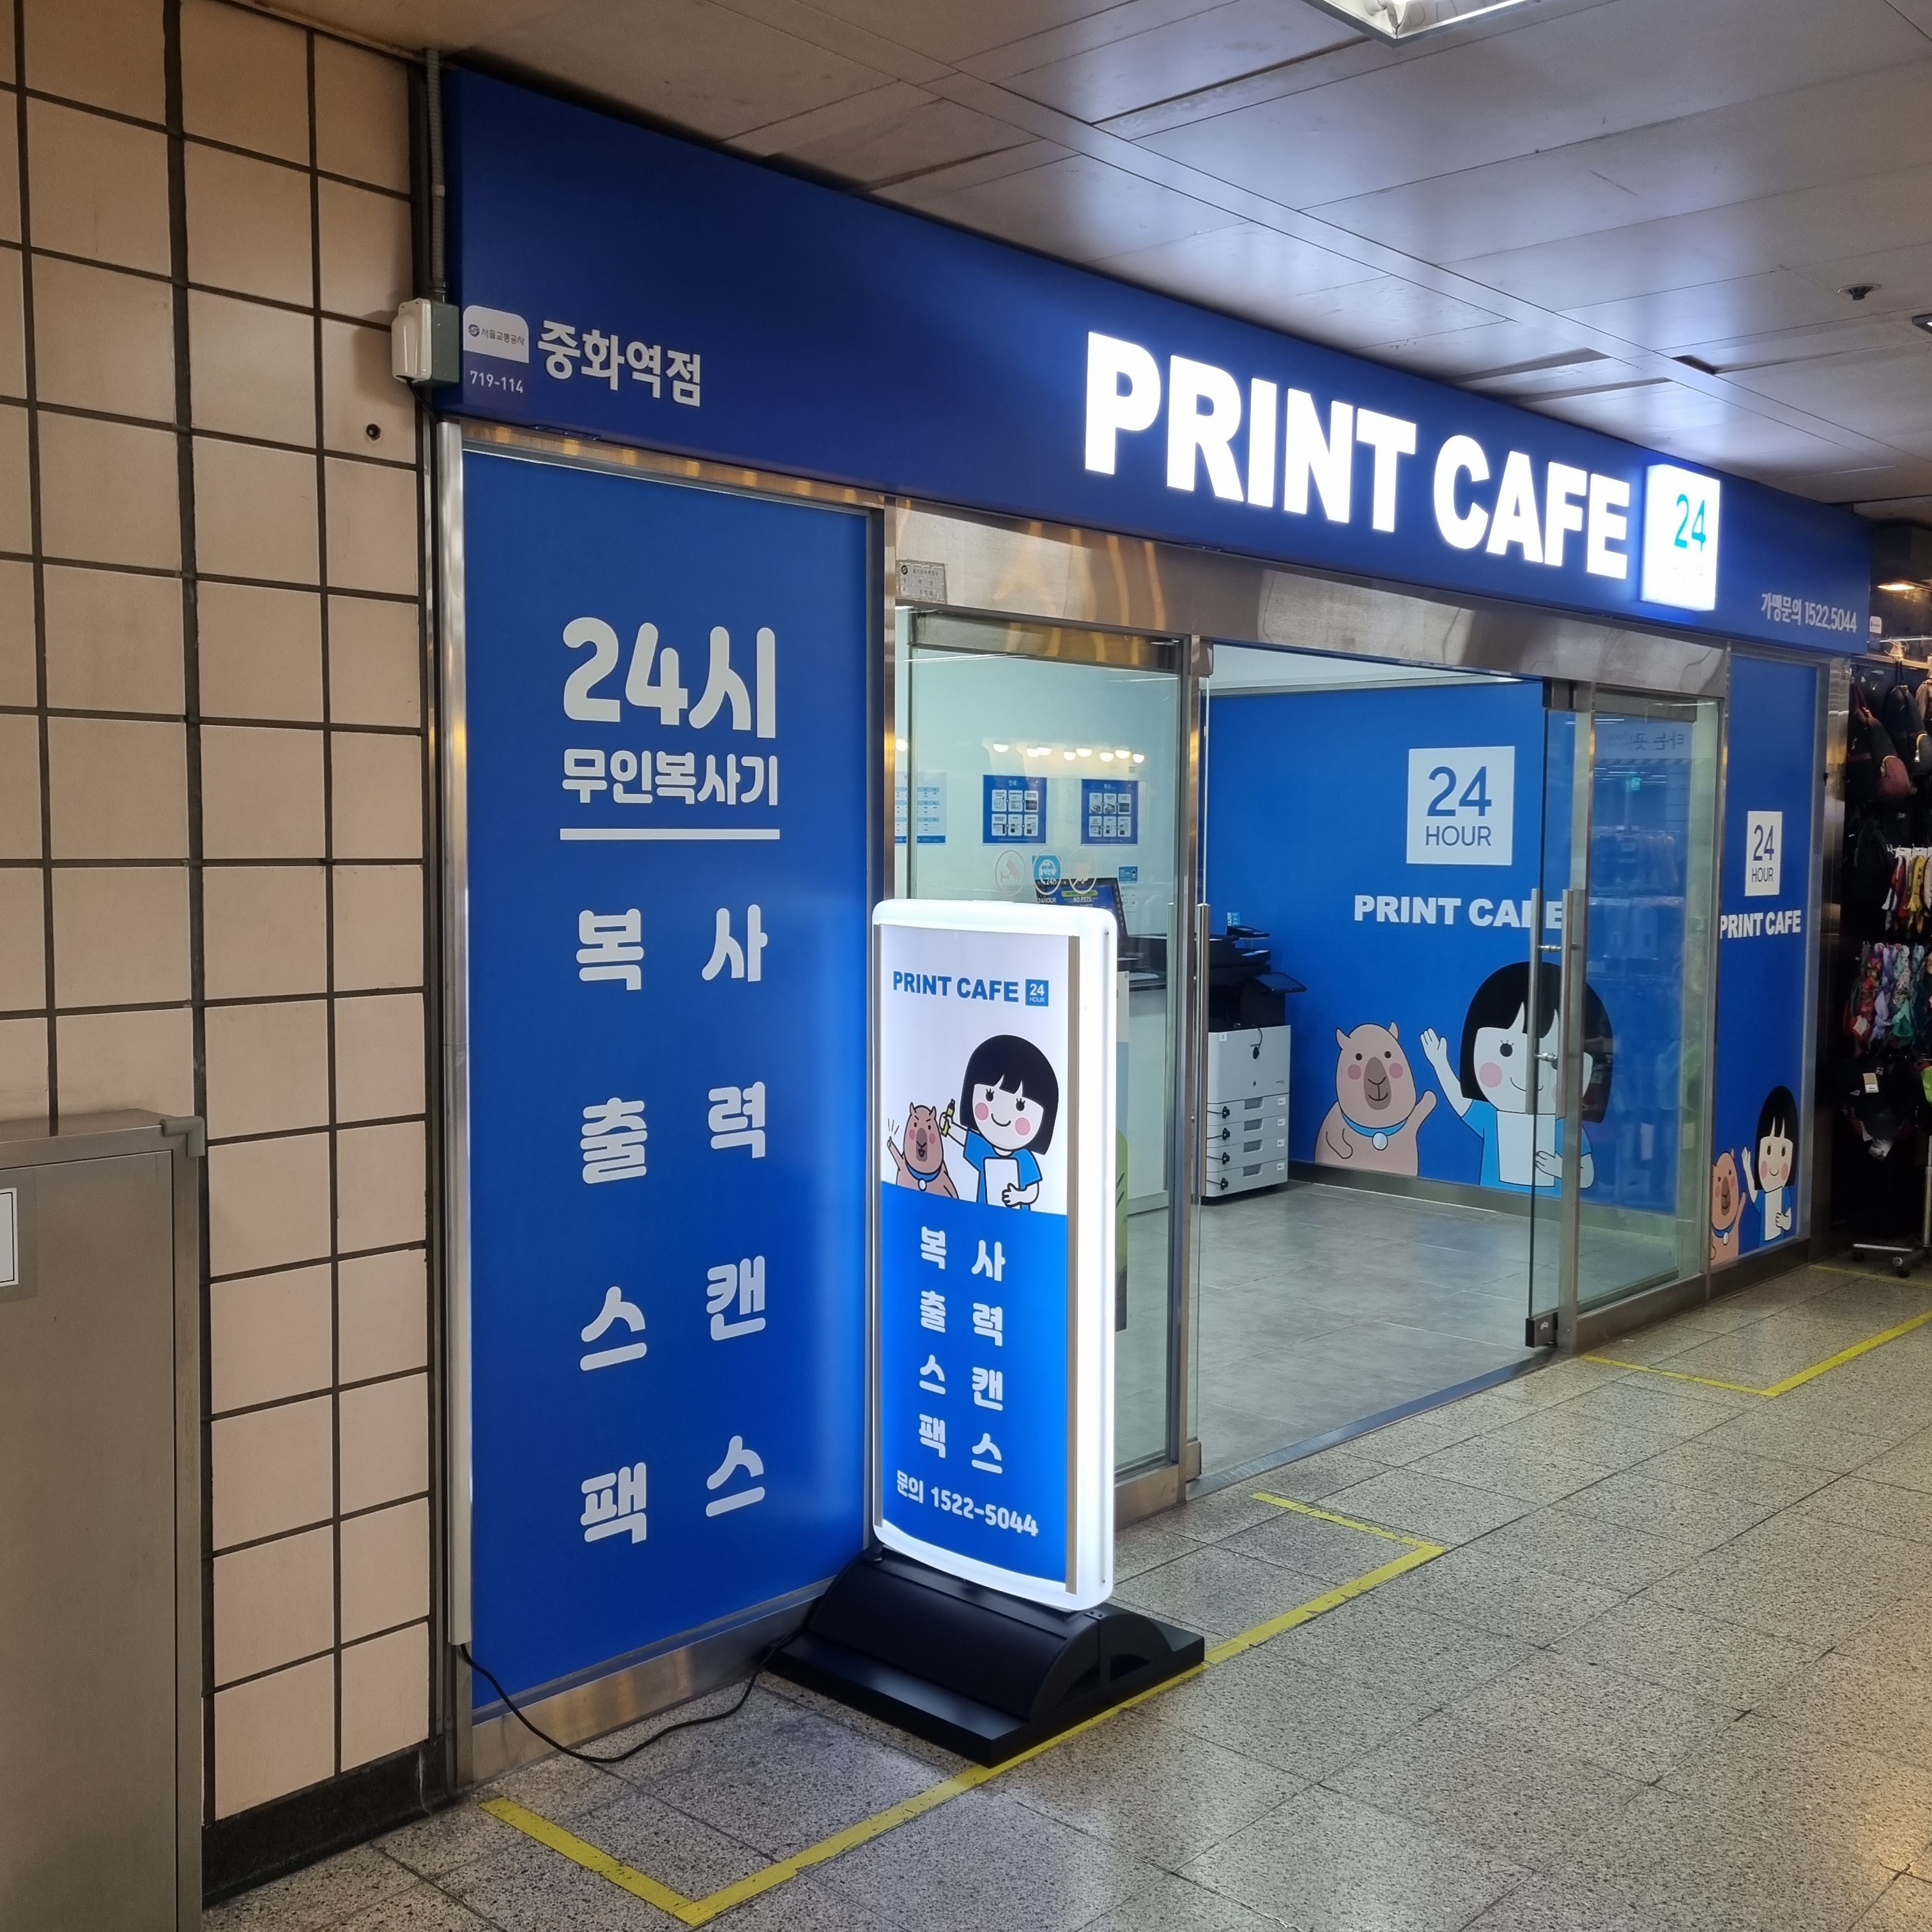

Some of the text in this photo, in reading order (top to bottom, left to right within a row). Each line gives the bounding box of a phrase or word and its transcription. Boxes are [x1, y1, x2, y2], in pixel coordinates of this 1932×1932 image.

[481, 328, 525, 346] 서울교통공사
[537, 319, 701, 407] 중화역점
[469, 370, 524, 394] 719-114
[1085, 331, 1630, 579] PRINT CAFE
[1674, 493, 1706, 552] 24
[1761, 592, 1857, 633] 가맹문의 1522.5044
[563, 617, 776, 739] 24시
[562, 748, 778, 806] 무인복사기
[1427, 766, 1492, 817] 24
[1425, 825, 1492, 847] HOUR
[1752, 824, 1775, 861] 24
[1751, 867, 1774, 882] HOUR
[1354, 895, 1461, 925] PRINT
[1720, 910, 1801, 939] PRINT CAFE
[893, 971, 1019, 1002] PRINT CAFE
[1029, 983, 1045, 996] 24
[896, 1469, 1039, 1537] 문의 1522-5044
